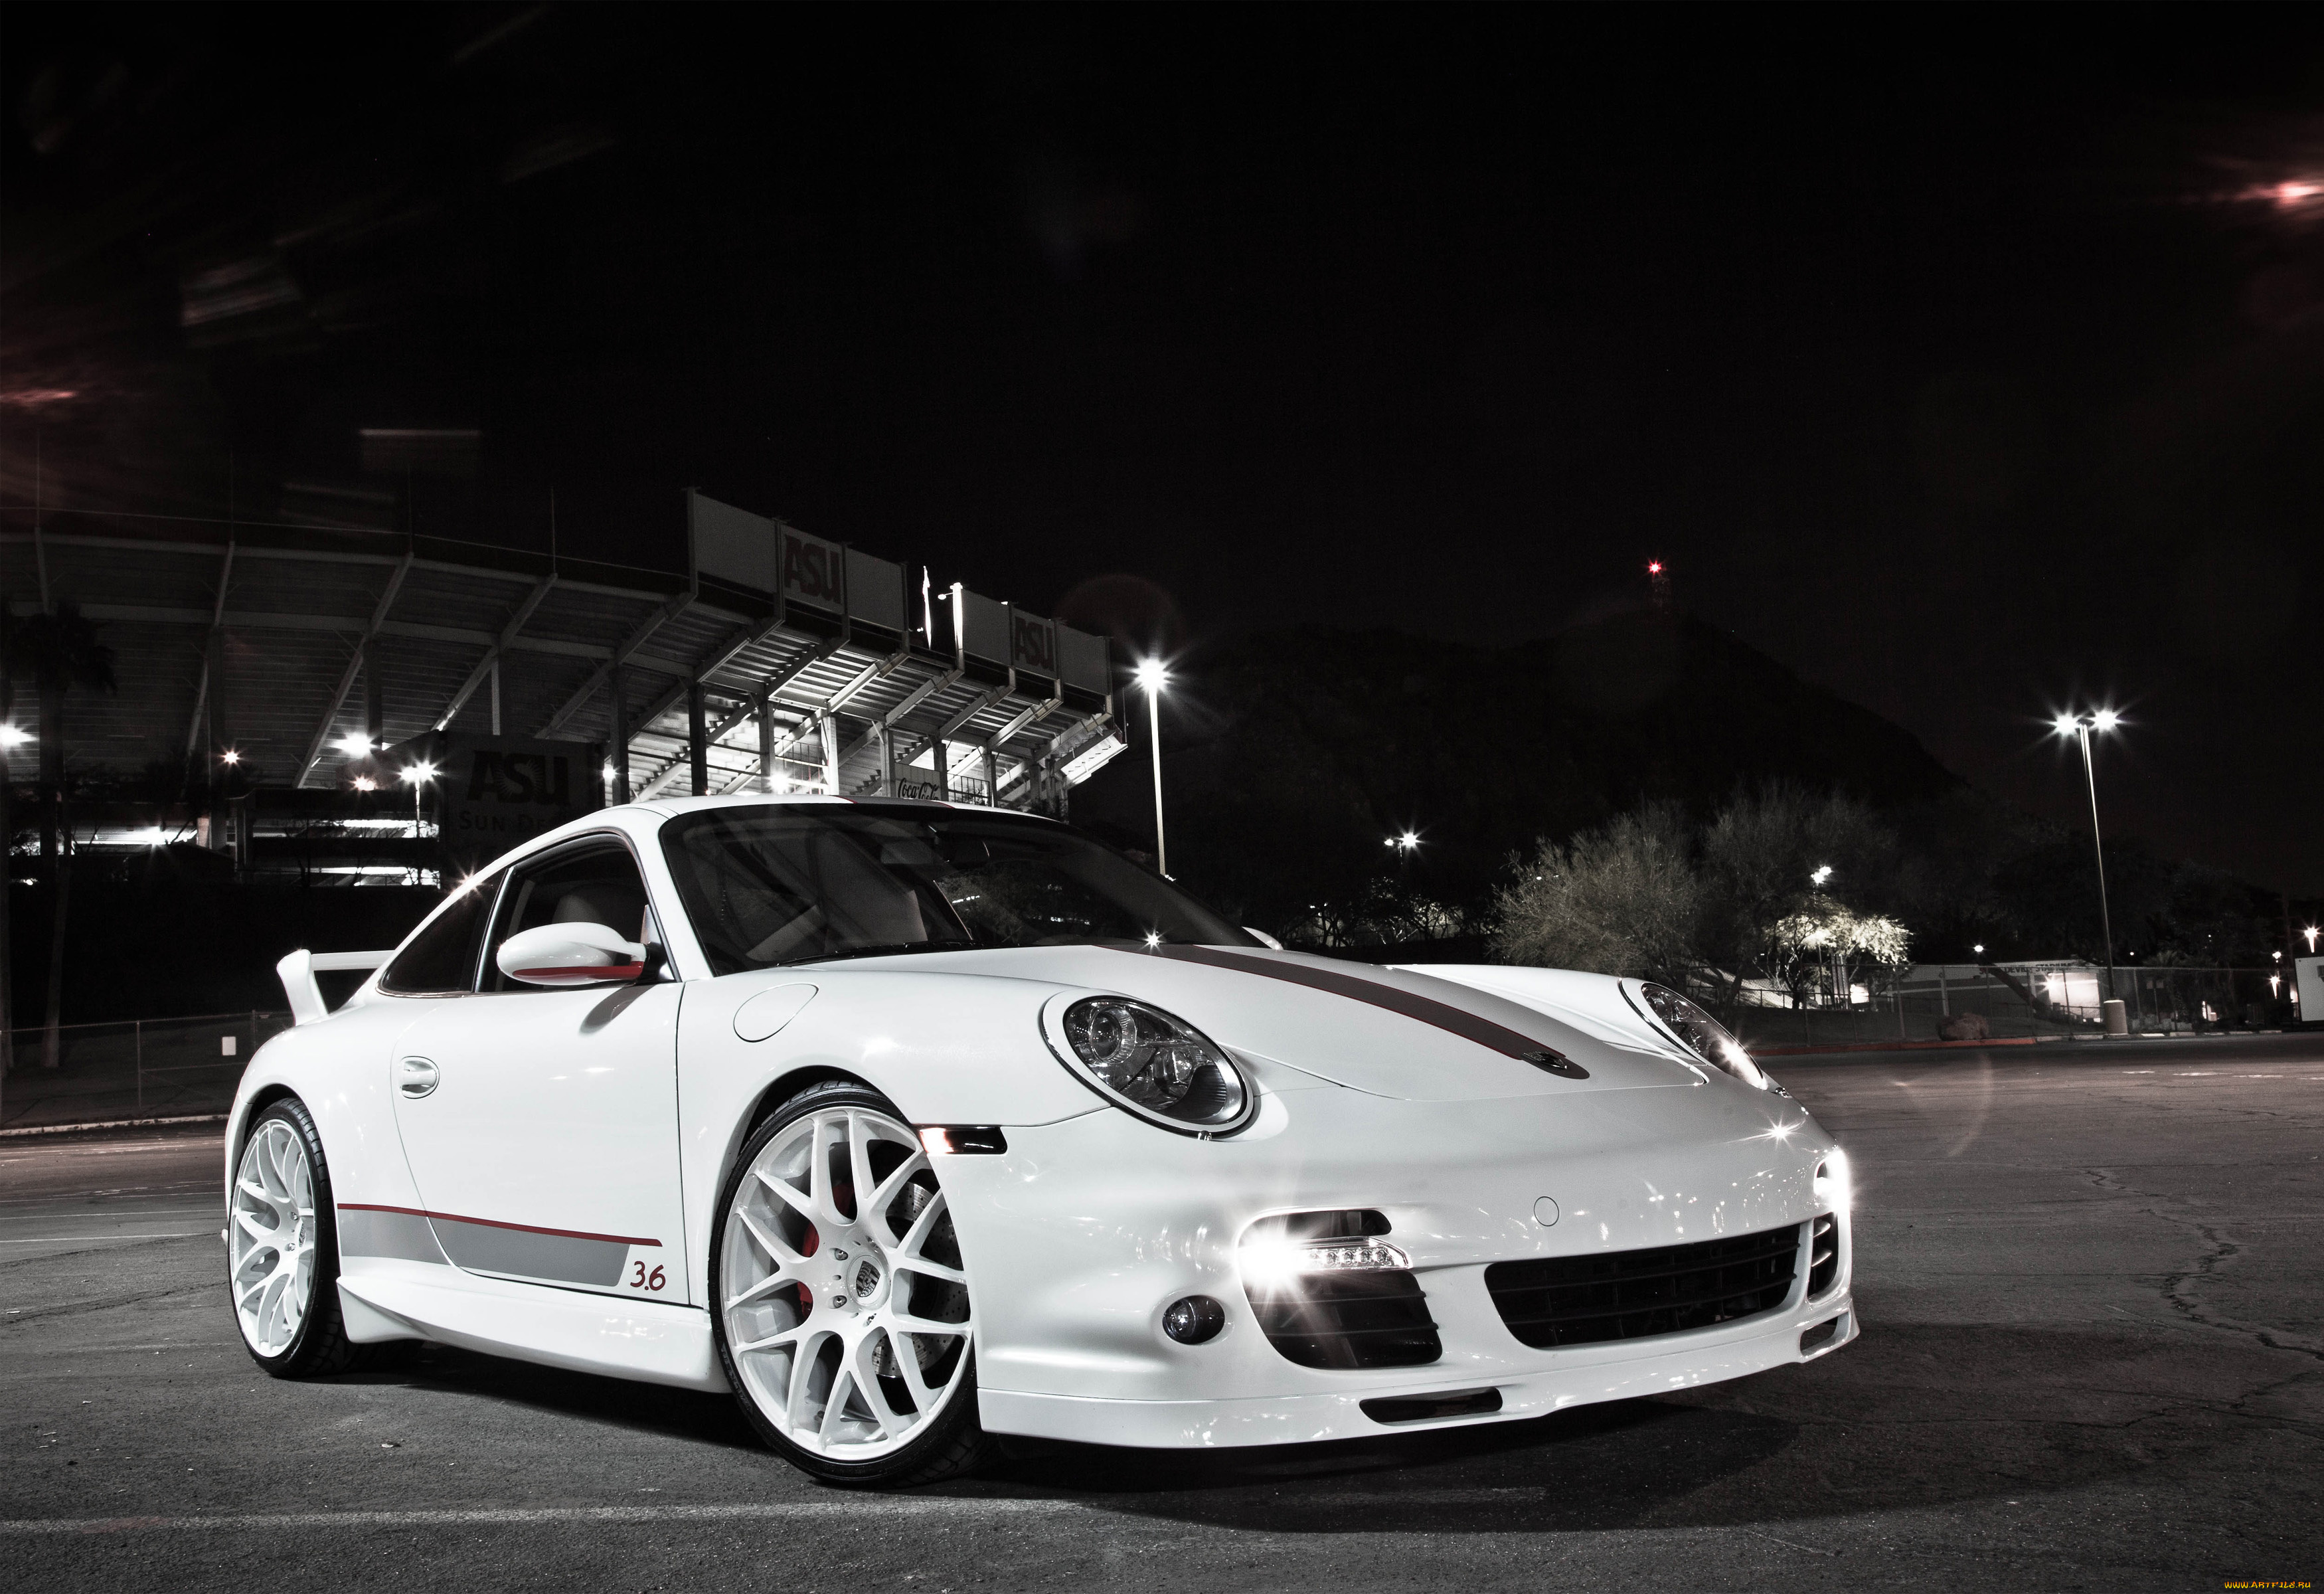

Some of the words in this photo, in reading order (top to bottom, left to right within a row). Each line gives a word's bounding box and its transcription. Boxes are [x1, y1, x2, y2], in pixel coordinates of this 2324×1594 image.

[784, 534, 841, 604] ASU
[1014, 616, 1054, 671] ASU
[467, 751, 571, 806] ASU
[630, 1261, 666, 1290] 3.6
